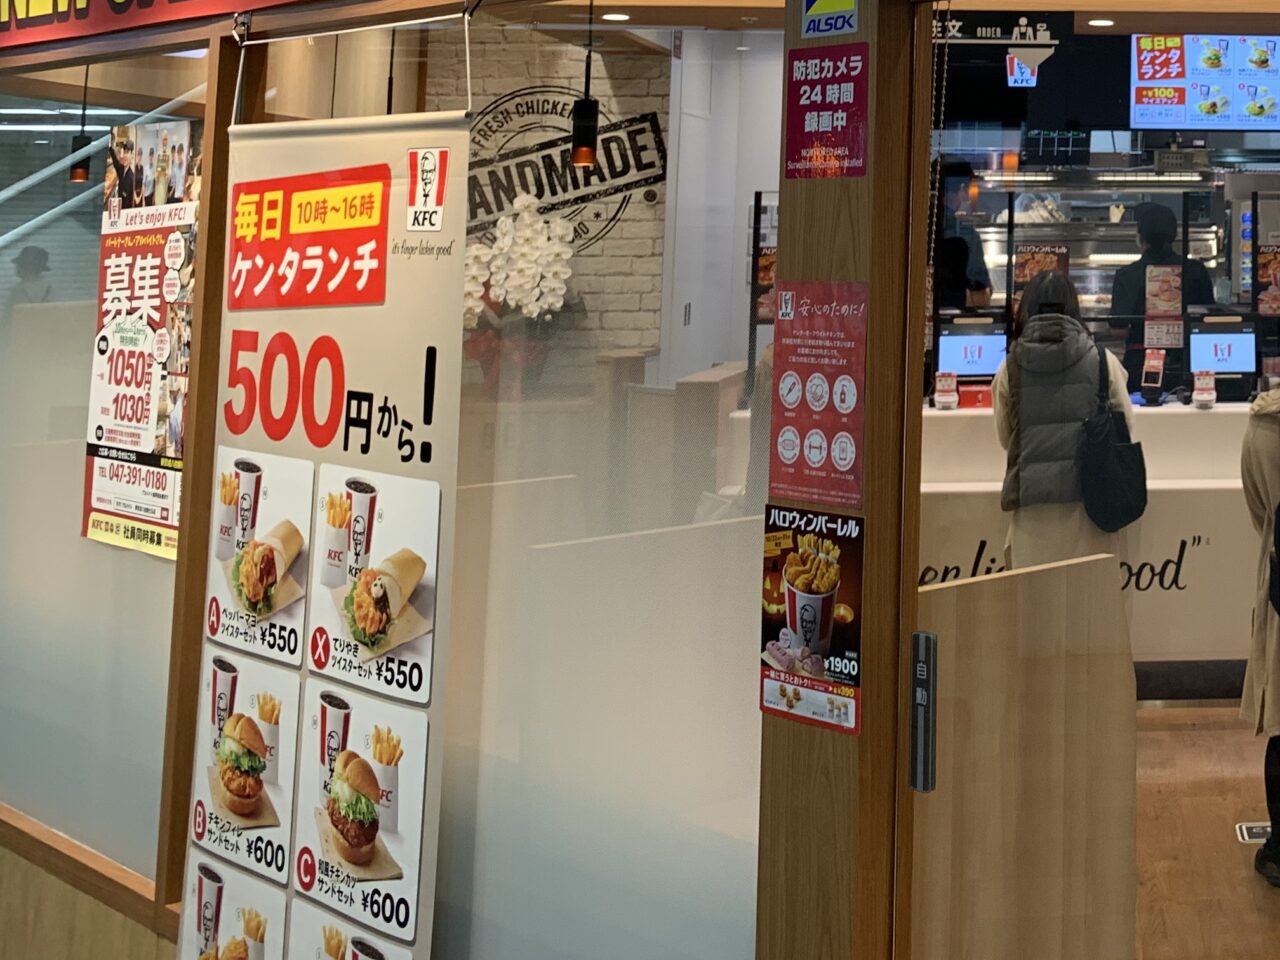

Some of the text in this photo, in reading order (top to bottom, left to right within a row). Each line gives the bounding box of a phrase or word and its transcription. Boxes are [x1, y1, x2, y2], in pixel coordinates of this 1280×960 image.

[805, 14, 855, 34] ALSOK
[793, 55, 863, 81] 防犯カメラ
[1013, 77, 1033, 86] KFC
[471, 110, 514, 148] FRESH
[804, 110, 847, 133] 録画中
[125, 207, 187, 226] Let's enjoy KFC!
[235, 190, 376, 243] 毎日 10時〜16時
[412, 210, 438, 227] KFC
[231, 239, 380, 299] ケンタランチ
[102, 252, 161, 326] 募集
[109, 462, 167, 492] 047-391-0180
[219, 524, 233, 537] KFC
[769, 508, 860, 539] ハロウィンバーレル
[235, 539, 248, 551] KF
[327, 548, 344, 562] KFC
[209, 605, 257, 628] A ペッパーマヨ
[221, 622, 298, 656] ツイスターセット ¥550
[314, 632, 360, 663] X てりやき
[331, 655, 423, 692] ツイスターセット ¥550
[824, 656, 858, 676] ¥1900
[264, 744, 275, 757] FC
[380, 789, 392, 803] FC
[196, 808, 204, 833] B
[207, 828, 285, 873] サンドセット ¥600
[302, 853, 357, 889] C 和風チキンカツ
[317, 875, 410, 929] サンドセット ¥600
